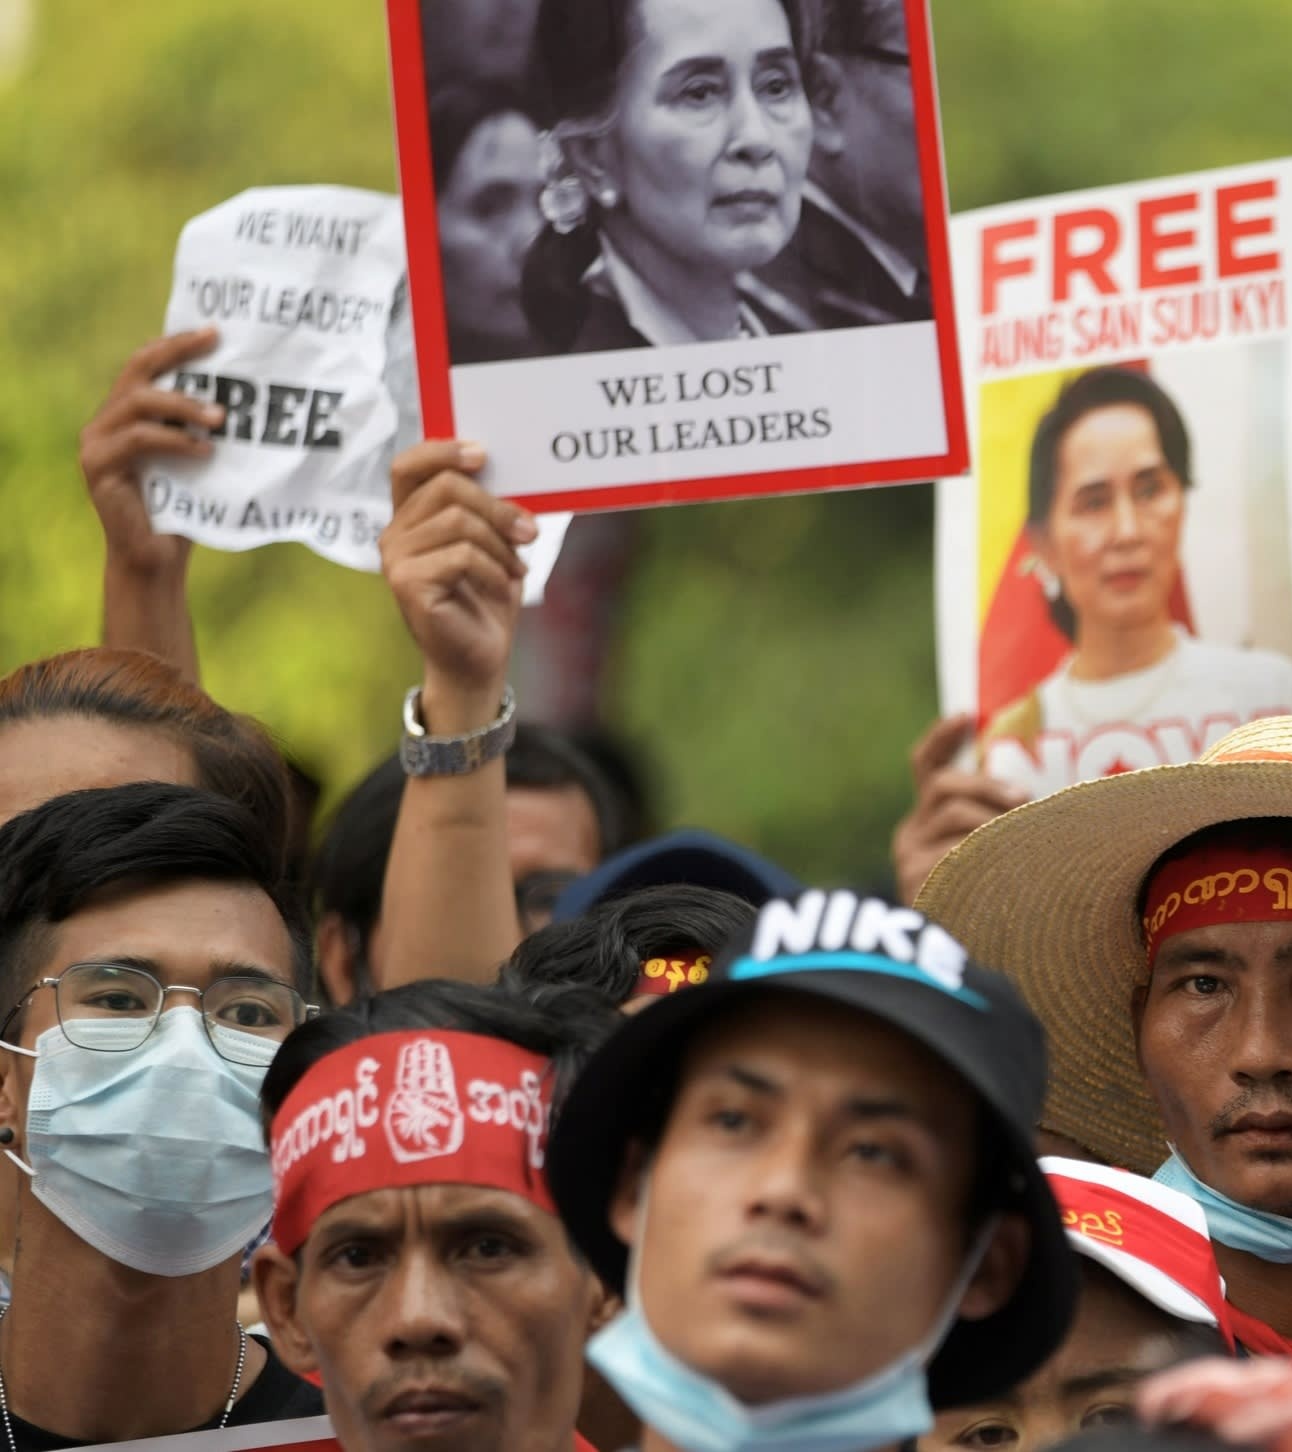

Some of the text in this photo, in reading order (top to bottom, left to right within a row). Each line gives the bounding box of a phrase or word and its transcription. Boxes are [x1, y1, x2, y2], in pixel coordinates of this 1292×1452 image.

[236, 208, 368, 256] WE WANT
[980, 178, 1280, 316] FREE
[980, 280, 1287, 370] AUNG SAN SUU KYI
[597, 362, 783, 408] WE LOST
[551, 408, 832, 462] OUR LEADERS
[752, 888, 967, 991] NIKE
